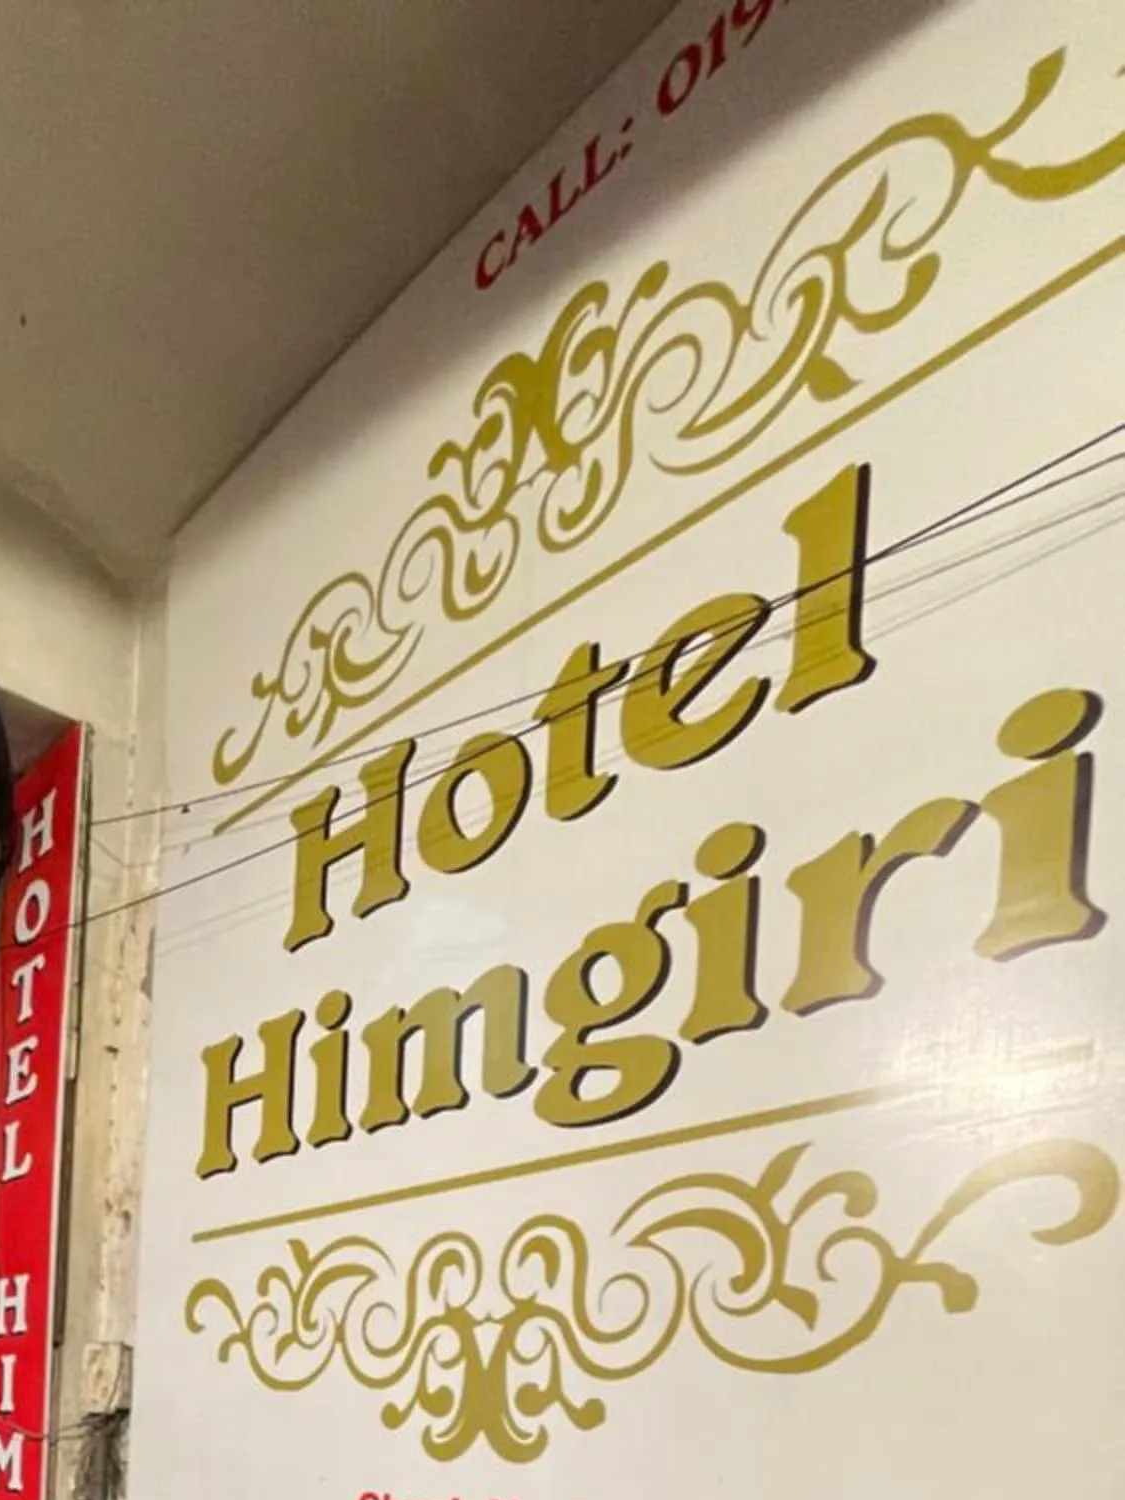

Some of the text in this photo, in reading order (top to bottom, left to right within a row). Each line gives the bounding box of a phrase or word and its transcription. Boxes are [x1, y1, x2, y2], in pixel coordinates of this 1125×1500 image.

[194, 688, 1108, 1180] Himgiri
[282, 462, 876, 953] Hotel
[1, 787, 57, 1183] HOTEL
